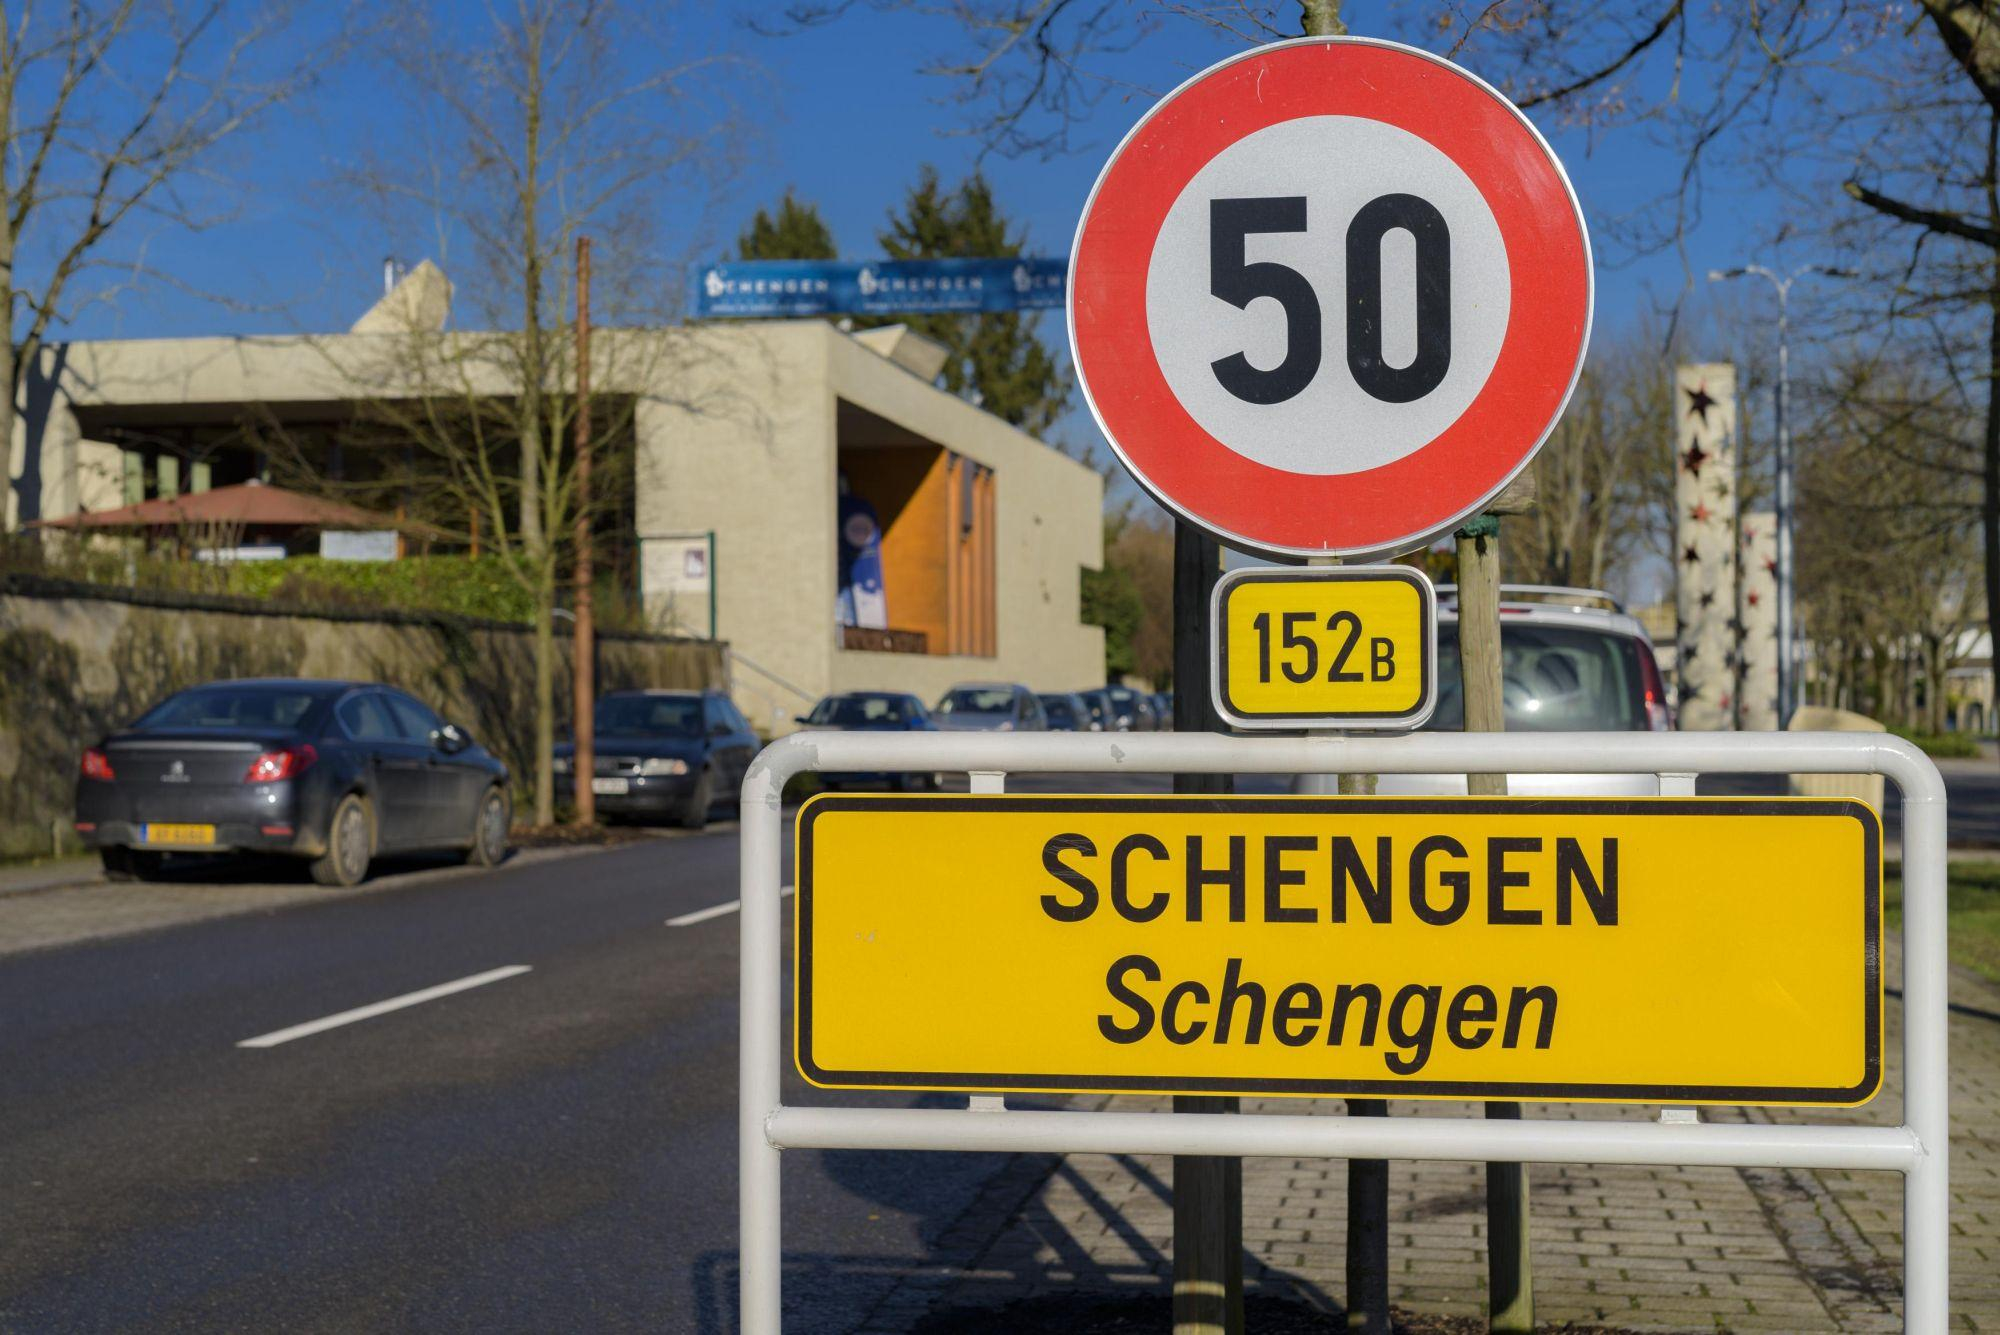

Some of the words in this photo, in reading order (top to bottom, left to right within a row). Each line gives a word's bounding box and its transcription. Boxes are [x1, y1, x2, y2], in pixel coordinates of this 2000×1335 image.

[1209, 192, 1452, 405] 50
[1253, 610, 1396, 684] 152B
[1040, 832, 1620, 927] SCHENGEN
[1097, 954, 1558, 1076] Schengen
